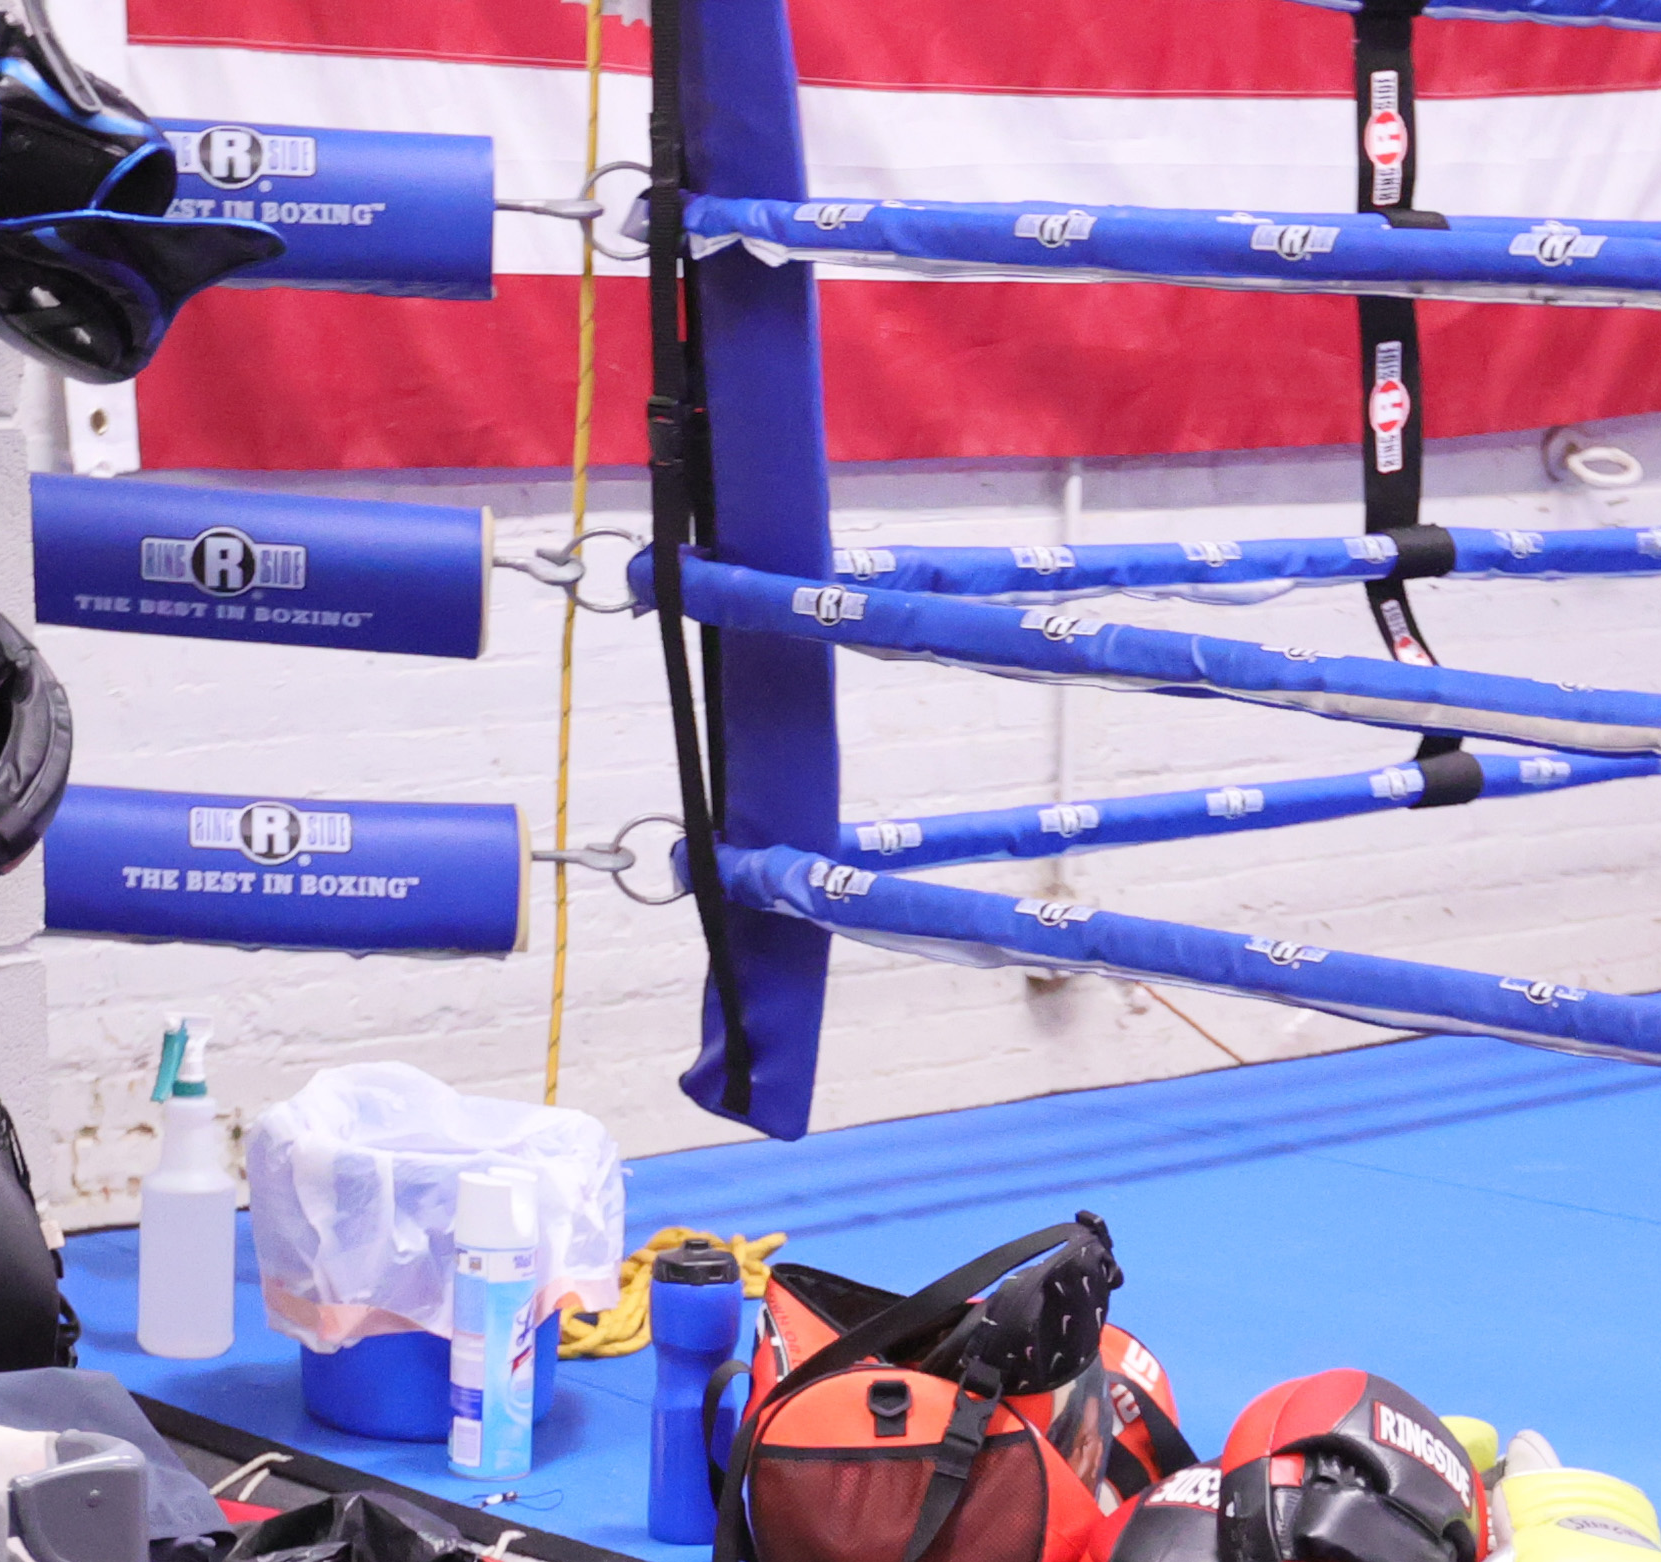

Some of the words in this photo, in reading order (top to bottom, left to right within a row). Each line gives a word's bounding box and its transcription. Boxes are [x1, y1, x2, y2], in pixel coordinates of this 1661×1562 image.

[222, 200, 255, 220] IN
[204, 535, 245, 589] R
[74, 594, 131, 613] THE
[139, 599, 208, 618] BEST
[216, 605, 246, 620] IN
[250, 805, 291, 855] R
[122, 866, 180, 890] THE
[186, 869, 256, 894] BEST
[262, 873, 294, 895] IN
[1378, 1404, 1472, 1509] RINGSIDE
